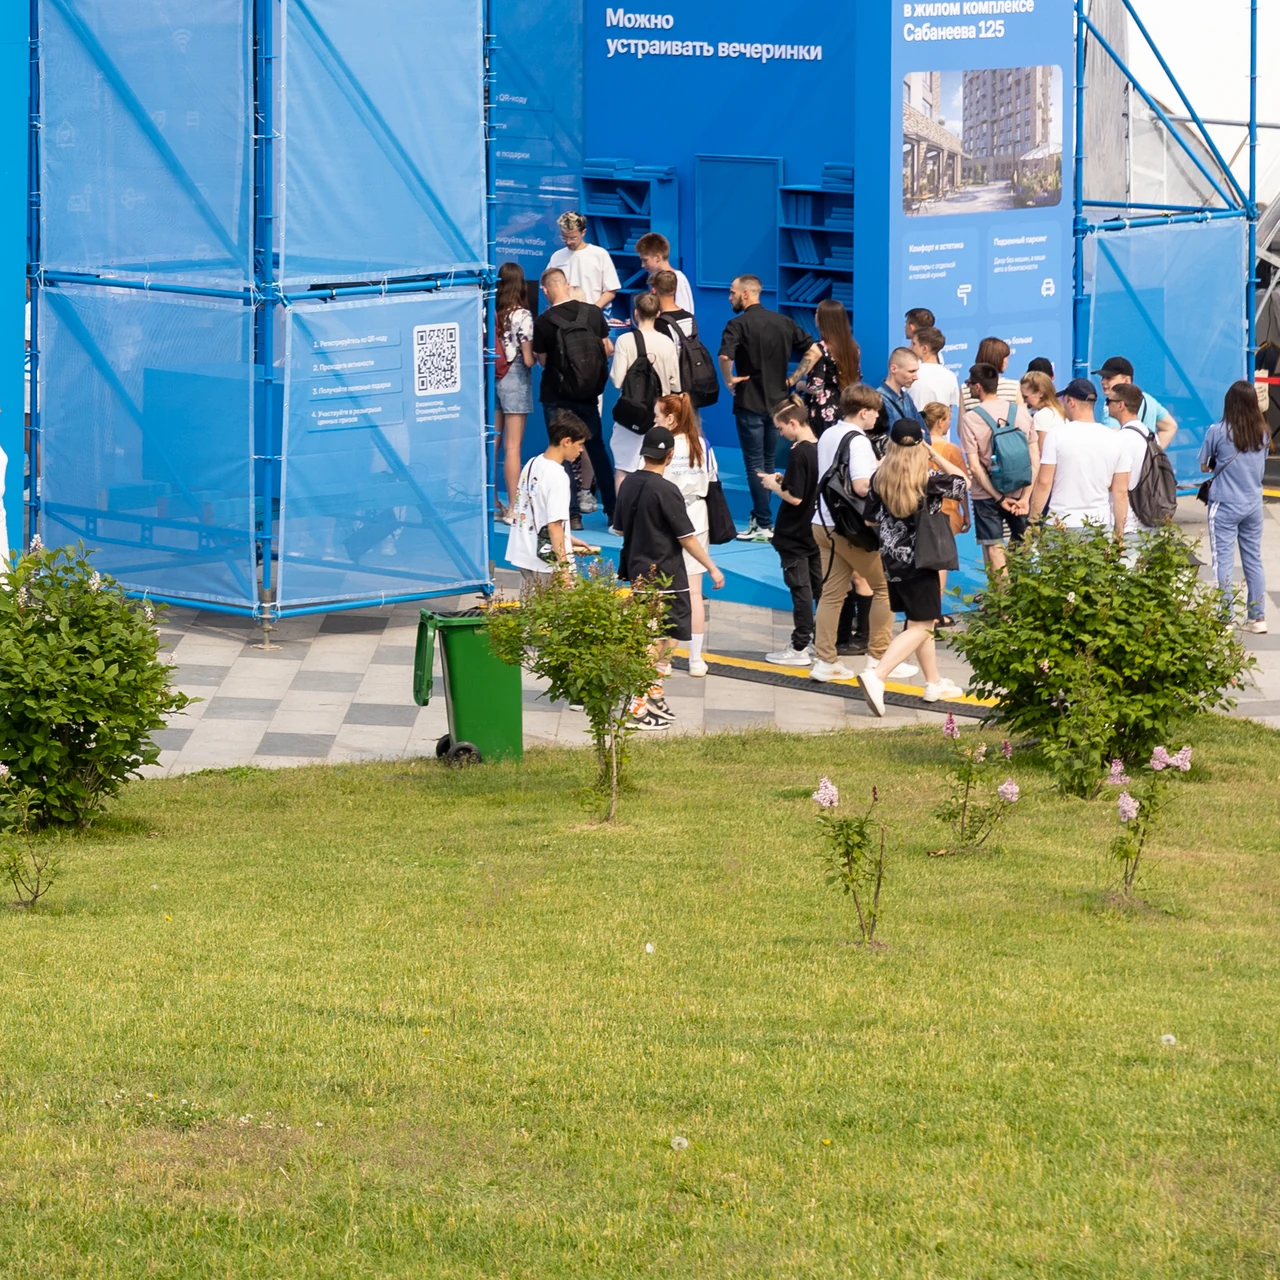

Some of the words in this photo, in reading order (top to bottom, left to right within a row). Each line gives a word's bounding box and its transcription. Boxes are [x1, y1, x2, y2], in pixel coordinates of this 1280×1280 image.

[606, 8, 674, 29] Можно
[903, 4, 912, 17] в
[914, 2, 960, 17] жилом
[963, 0, 1035, 15] комплексе
[903, 22, 976, 41] Сабанеева
[978, 20, 1005, 38] 125
[606, 38, 714, 58] устраивать
[717, 41, 822, 63] вечеринки
[909, 244, 934, 254] Комфорт
